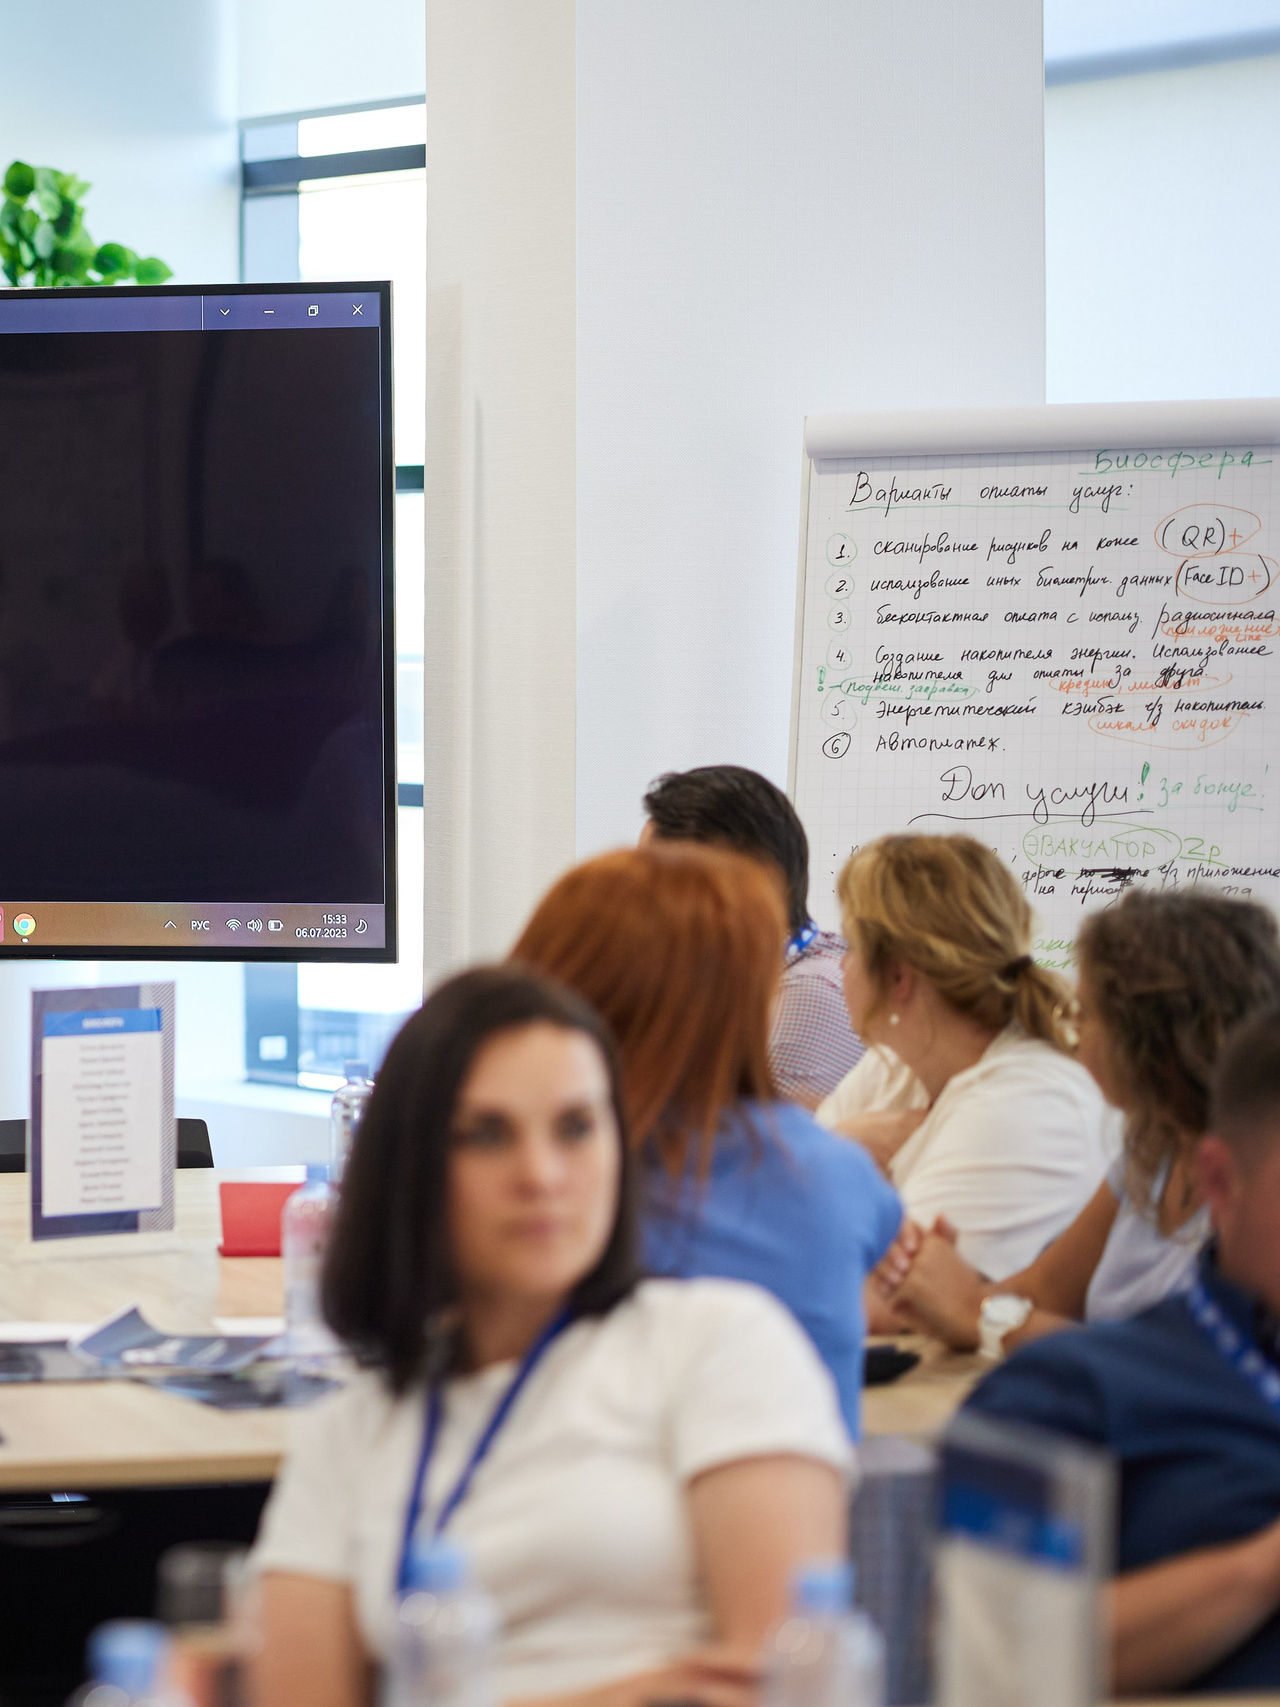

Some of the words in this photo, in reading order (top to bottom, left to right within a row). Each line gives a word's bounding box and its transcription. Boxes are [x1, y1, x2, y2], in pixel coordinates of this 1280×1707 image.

[1095, 449, 1254, 479] Биосфера
[849, 471, 952, 517] Варианты
[979, 486, 1048, 499] оплаты
[1069, 484, 1133, 513] услуг:
[873, 532, 978, 564] сканирование
[986, 528, 1051, 564] рисунков
[1062, 539, 1078, 551] на
[1116, 575, 1173, 597] данных
[876, 603, 989, 625] бесконтактная
[1004, 610, 1058, 623] оплата
[1151, 602, 1276, 640] радиосигнала
[875, 645, 945, 675] Создание
[960, 649, 1053, 661] накопителя
[873, 668, 963, 682] накопителя
[1026, 834, 1156, 861] ЭВАКУАТОР
[191, 921, 210, 930] РУС
[322, 914, 347, 924] 15:33
[295, 928, 348, 938] 06.07.2023
